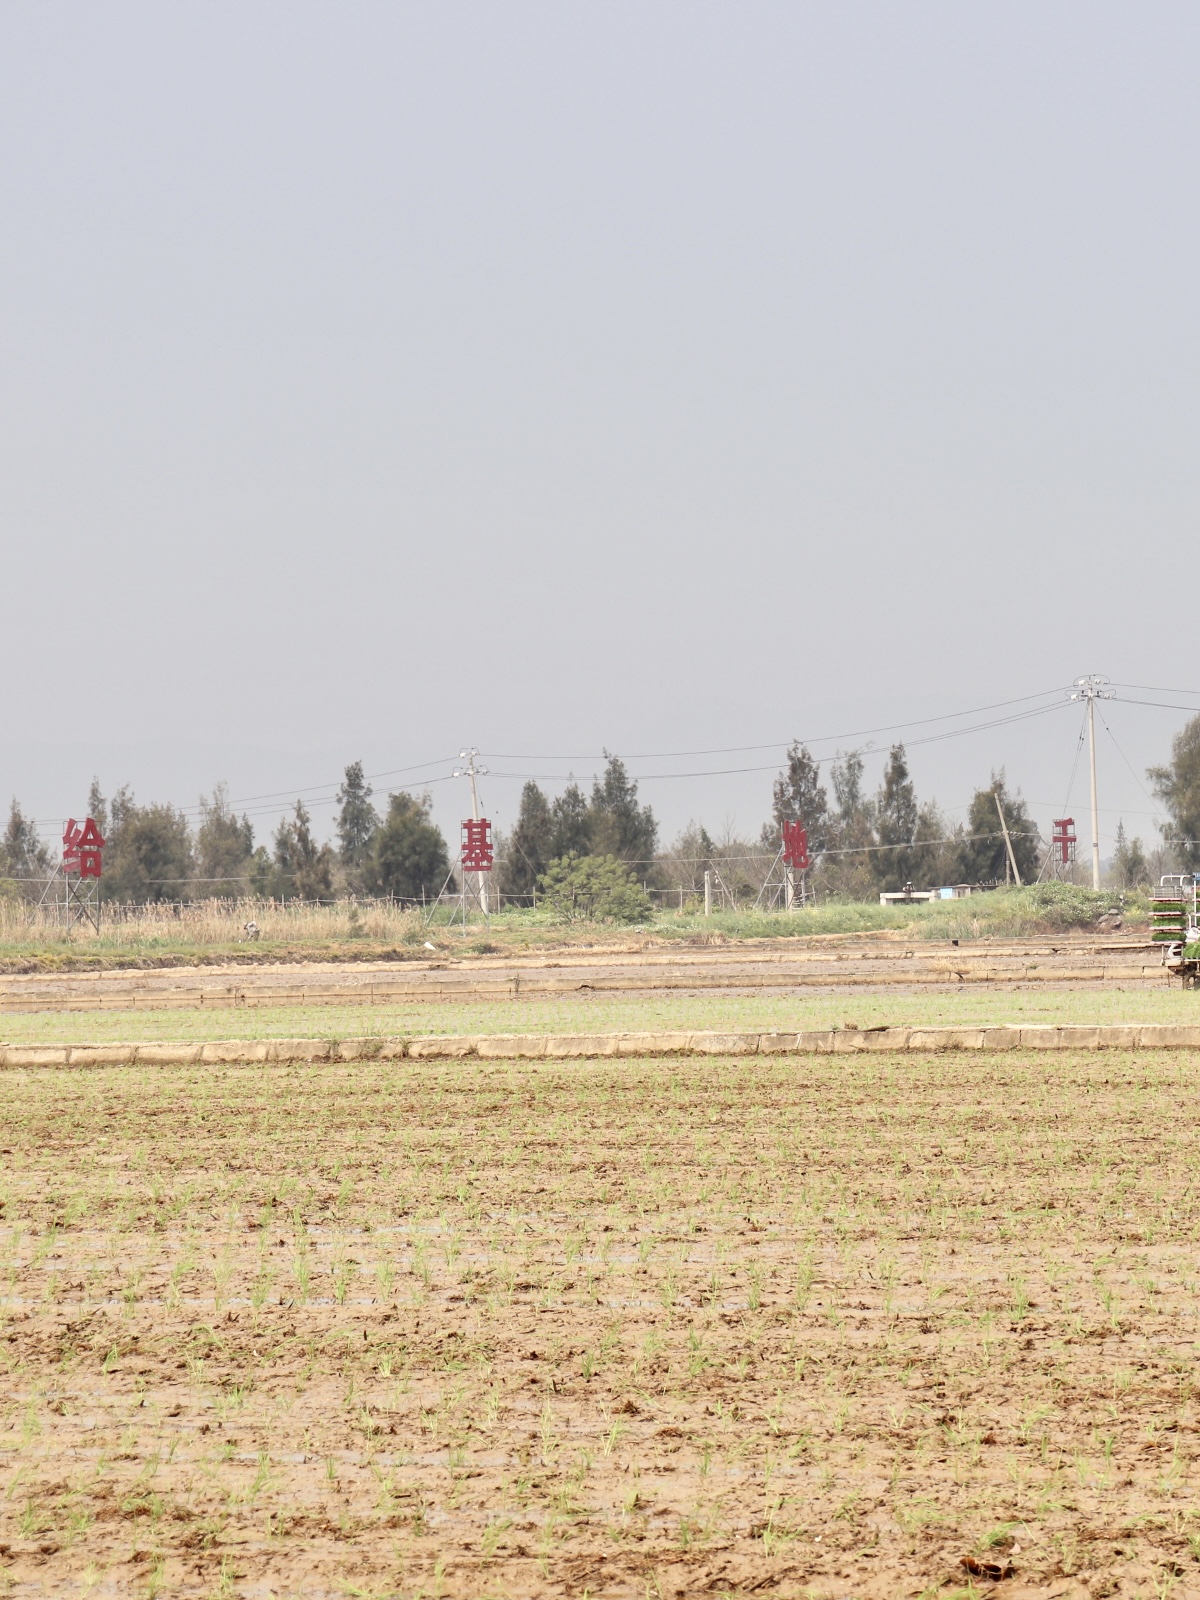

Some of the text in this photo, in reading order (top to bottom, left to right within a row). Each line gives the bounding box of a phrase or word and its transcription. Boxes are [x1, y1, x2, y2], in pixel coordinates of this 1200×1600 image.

[62, 817, 106, 877] 给
[461, 817, 493, 871] 基
[783, 820, 809, 868] 地
[1053, 818, 1077, 864] 千
